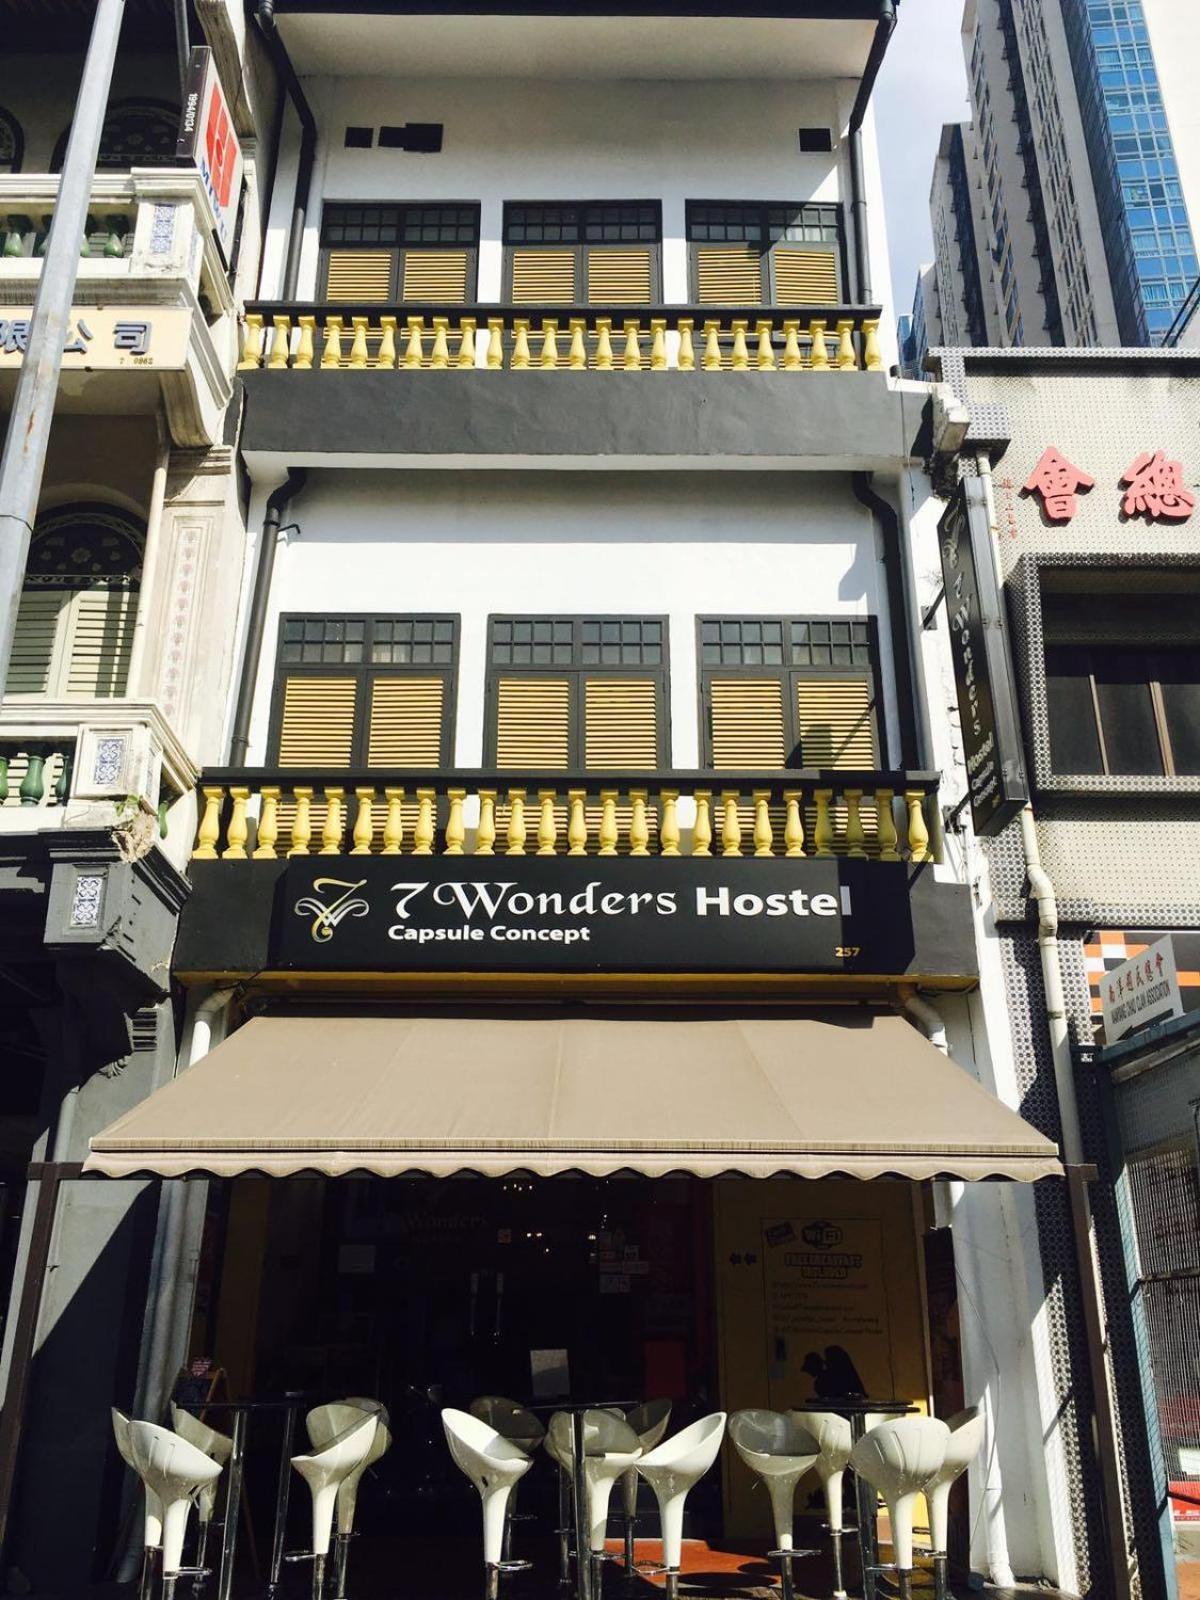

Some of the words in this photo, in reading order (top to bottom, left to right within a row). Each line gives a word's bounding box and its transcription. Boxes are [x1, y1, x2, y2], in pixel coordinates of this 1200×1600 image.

[390, 881, 430, 920] 7
[432, 881, 677, 920] Wonders
[696, 885, 852, 916] Hostel
[388, 924, 485, 943] Capsule
[490, 925, 591, 944] Concept
[835, 947, 860, 958] 257
